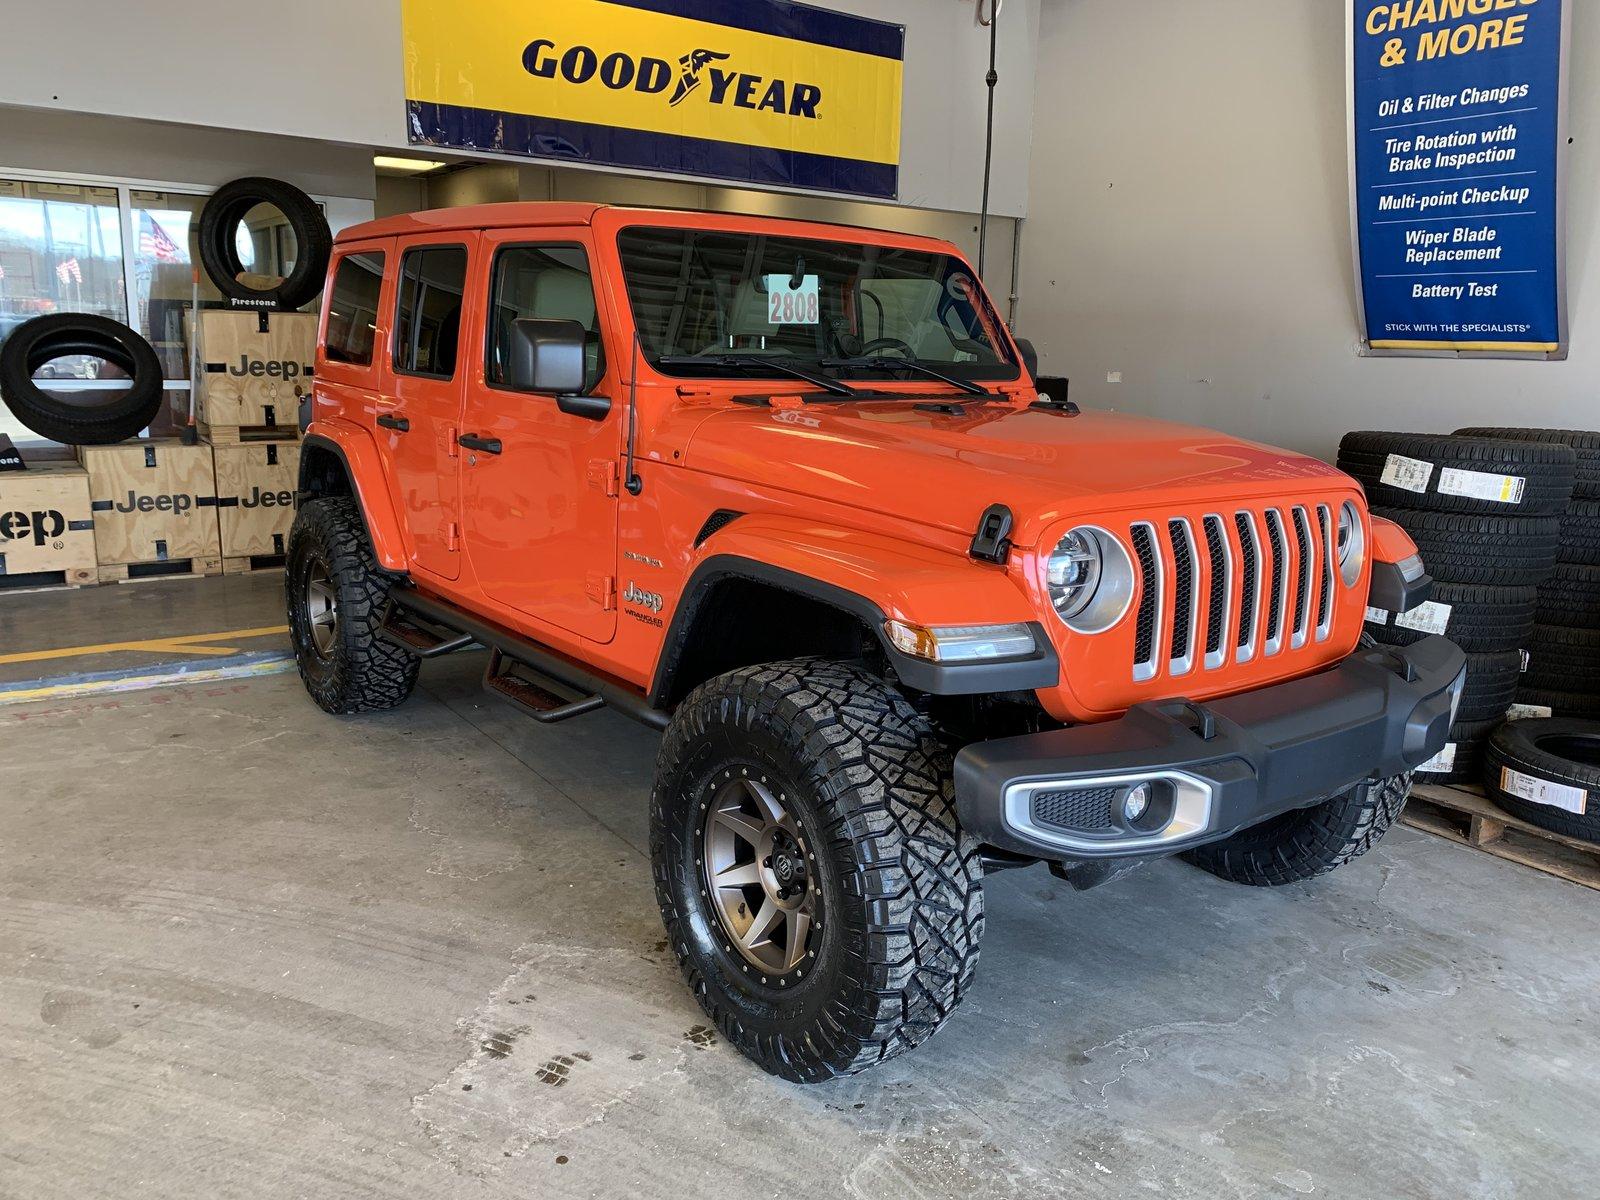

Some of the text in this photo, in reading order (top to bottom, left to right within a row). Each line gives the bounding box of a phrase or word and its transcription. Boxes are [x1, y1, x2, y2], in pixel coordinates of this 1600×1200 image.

[1365, 0, 1539, 35] CHANG
[1379, 14, 1529, 67] & MORE
[1378, 84, 1529, 117] Oil & Filter Changes
[1385, 124, 1517, 154] Tire Rotation with
[1389, 146, 1516, 173] Brake Inspection
[1378, 186, 1530, 211] Multi-point Checkup
[1405, 226, 1497, 248] Wiper Blade
[1405, 245, 1502, 266] Replacement
[231, 298, 276, 307] Firestone
[1412, 282, 1498, 300] Battery Test
[771, 292, 818, 322] 2808
[1385, 323, 1411, 332] STICK
[1413, 324, 1438, 332] WITH
[1440, 324, 1460, 332] THE
[229, 354, 299, 381] Jeep
[116, 490, 192, 515] Jeep
[624, 580, 663, 614] Jeep
